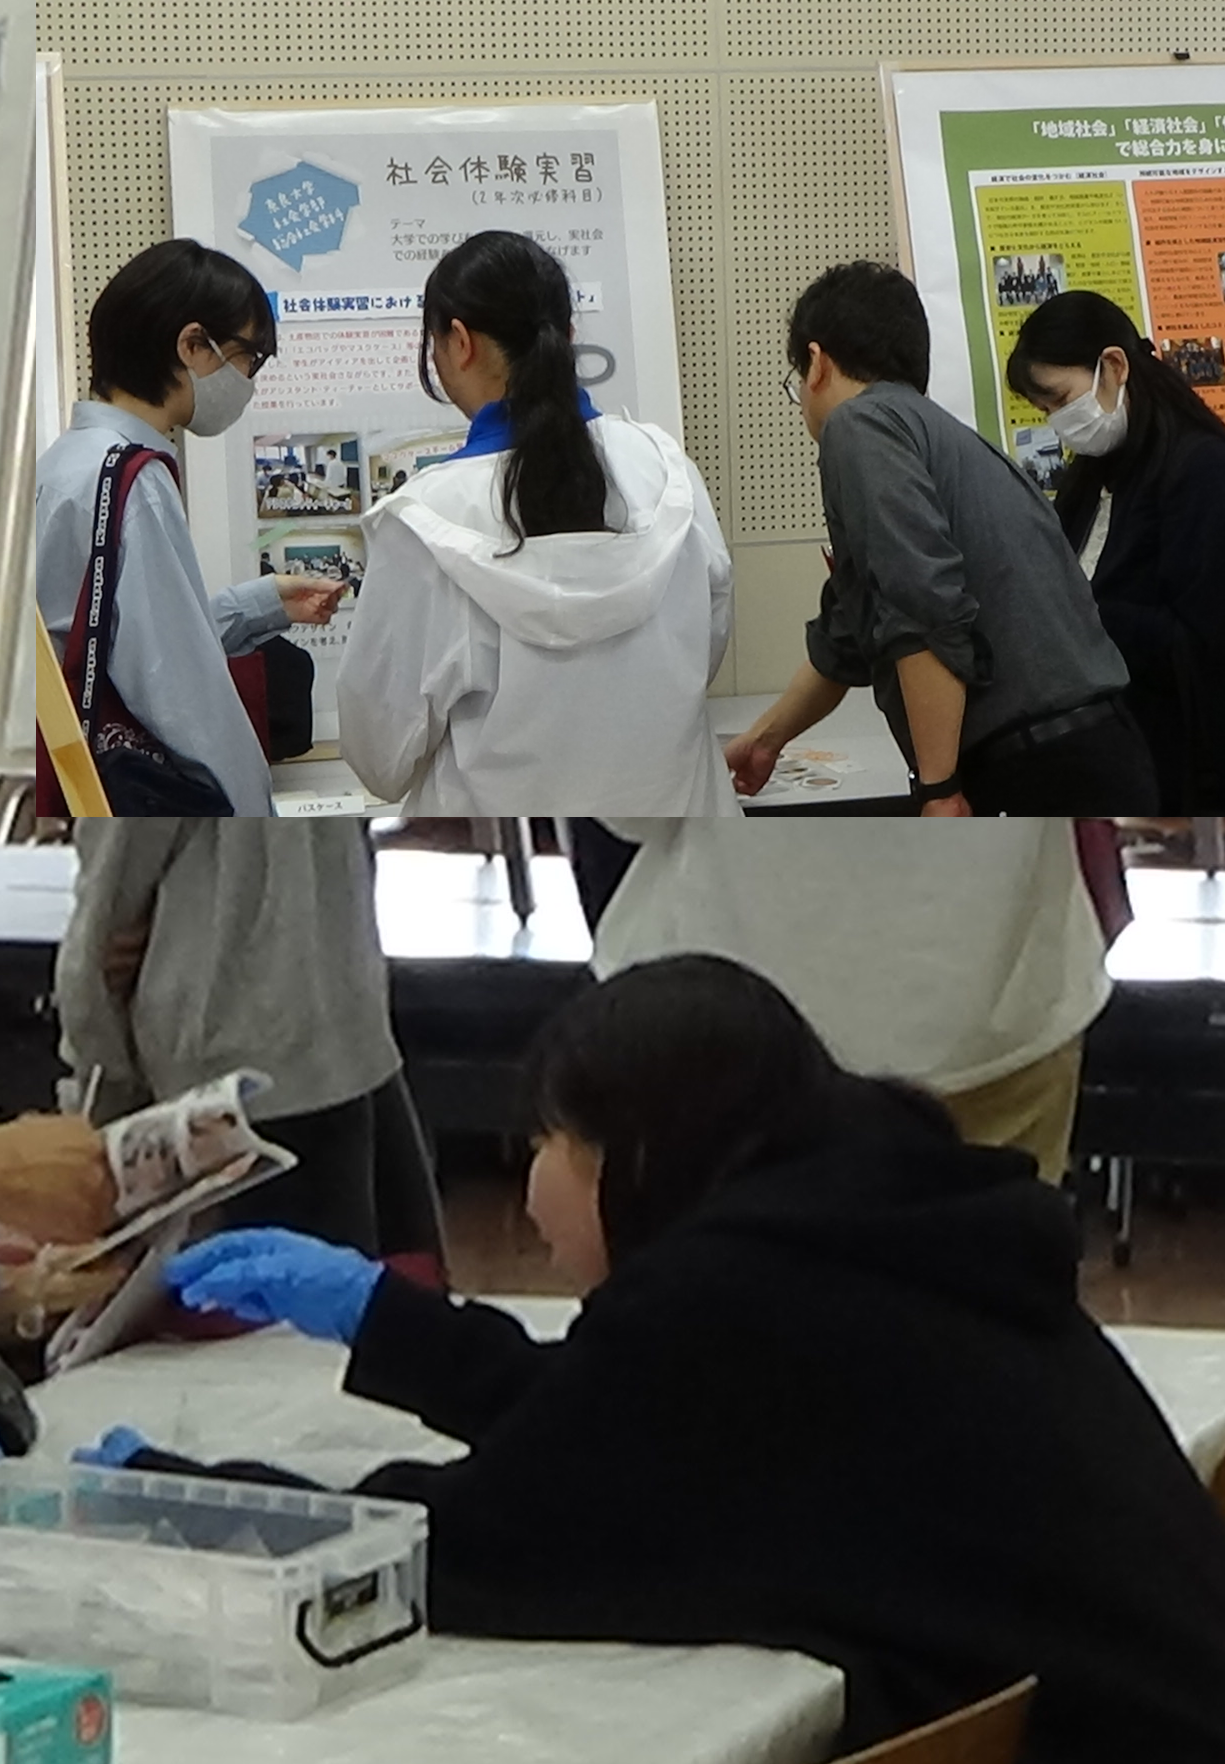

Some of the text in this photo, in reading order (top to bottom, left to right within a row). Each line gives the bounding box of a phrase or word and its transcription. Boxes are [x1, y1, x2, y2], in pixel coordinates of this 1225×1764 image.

[1031, 114, 1225, 139] 「地域社会」「経済社会」「
[386, 152, 596, 186] 社会体験実習
[390, 218, 426, 230] テーマ
